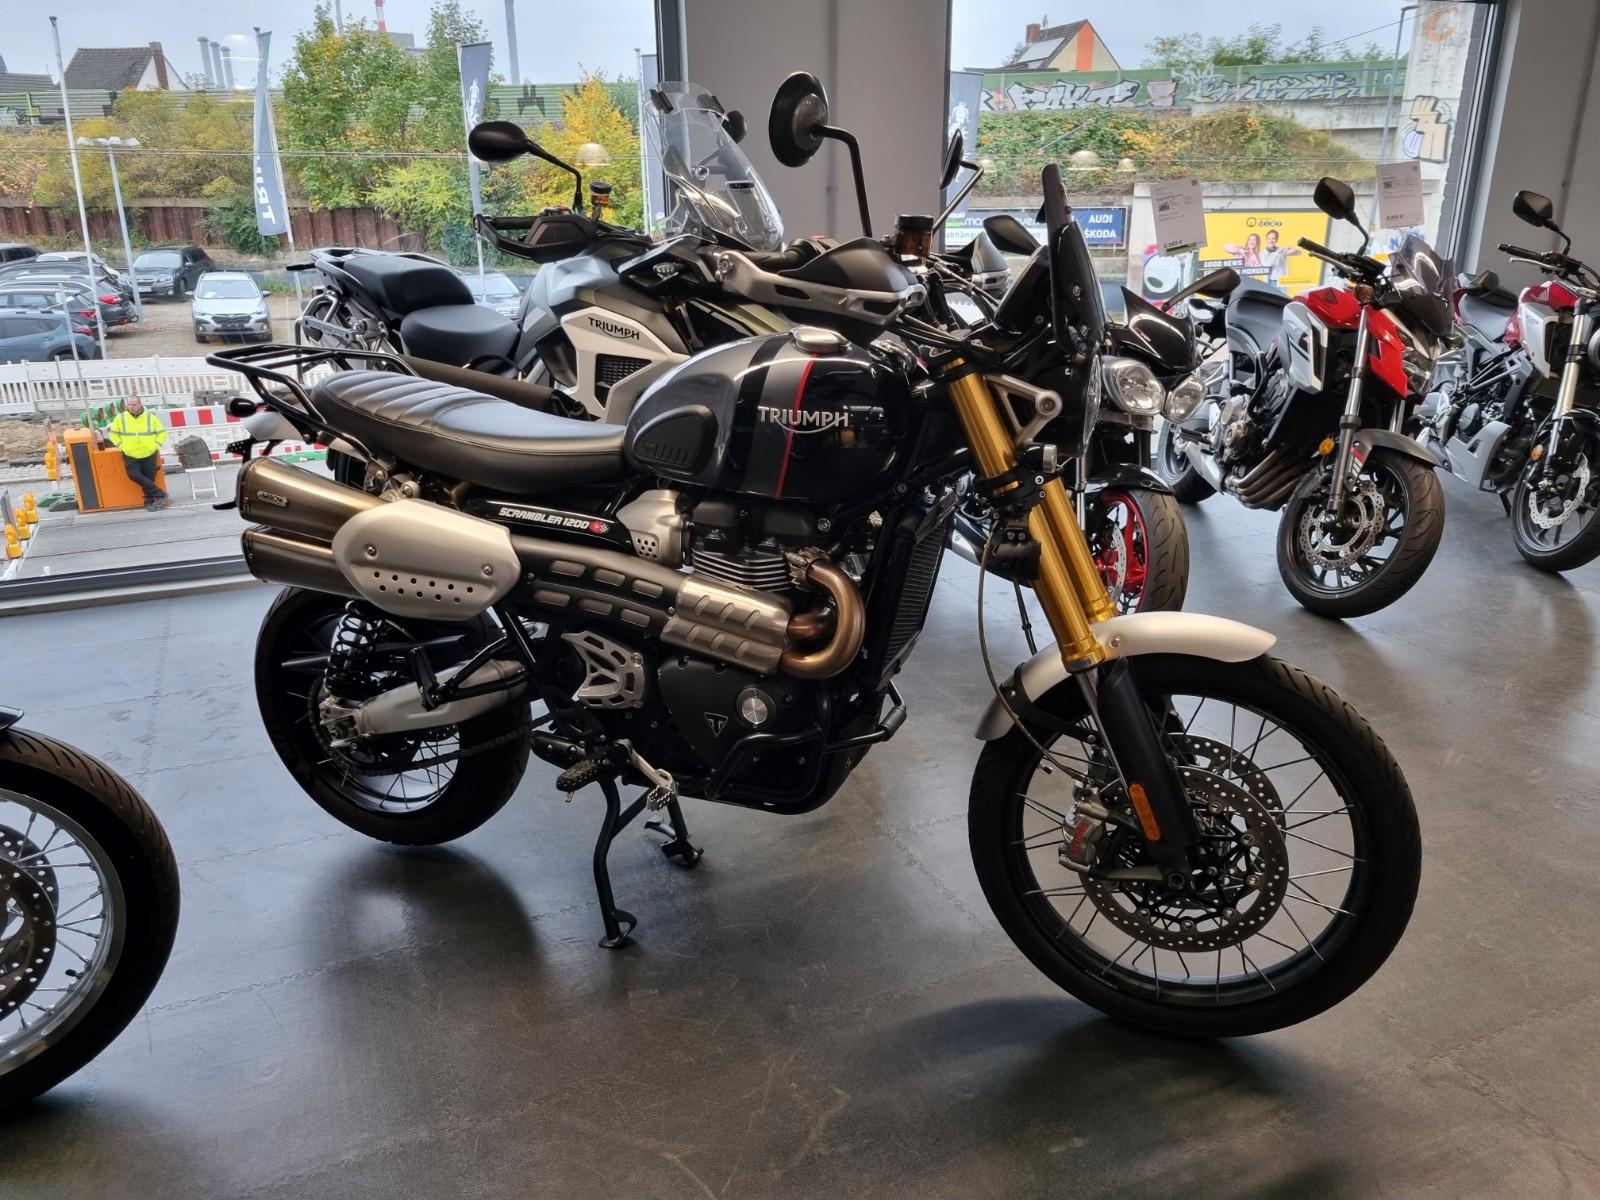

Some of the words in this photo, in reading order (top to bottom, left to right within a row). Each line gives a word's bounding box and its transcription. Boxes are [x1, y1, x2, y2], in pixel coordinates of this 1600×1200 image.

[1088, 214, 1113, 224] AUDI
[1084, 227, 1117, 239] ŠKODA
[588, 317, 640, 341] TRIUMPH
[757, 405, 849, 430] TRIUMPH
[498, 507, 562, 526] SCRAMBLER
[562, 518, 590, 530] 1200
